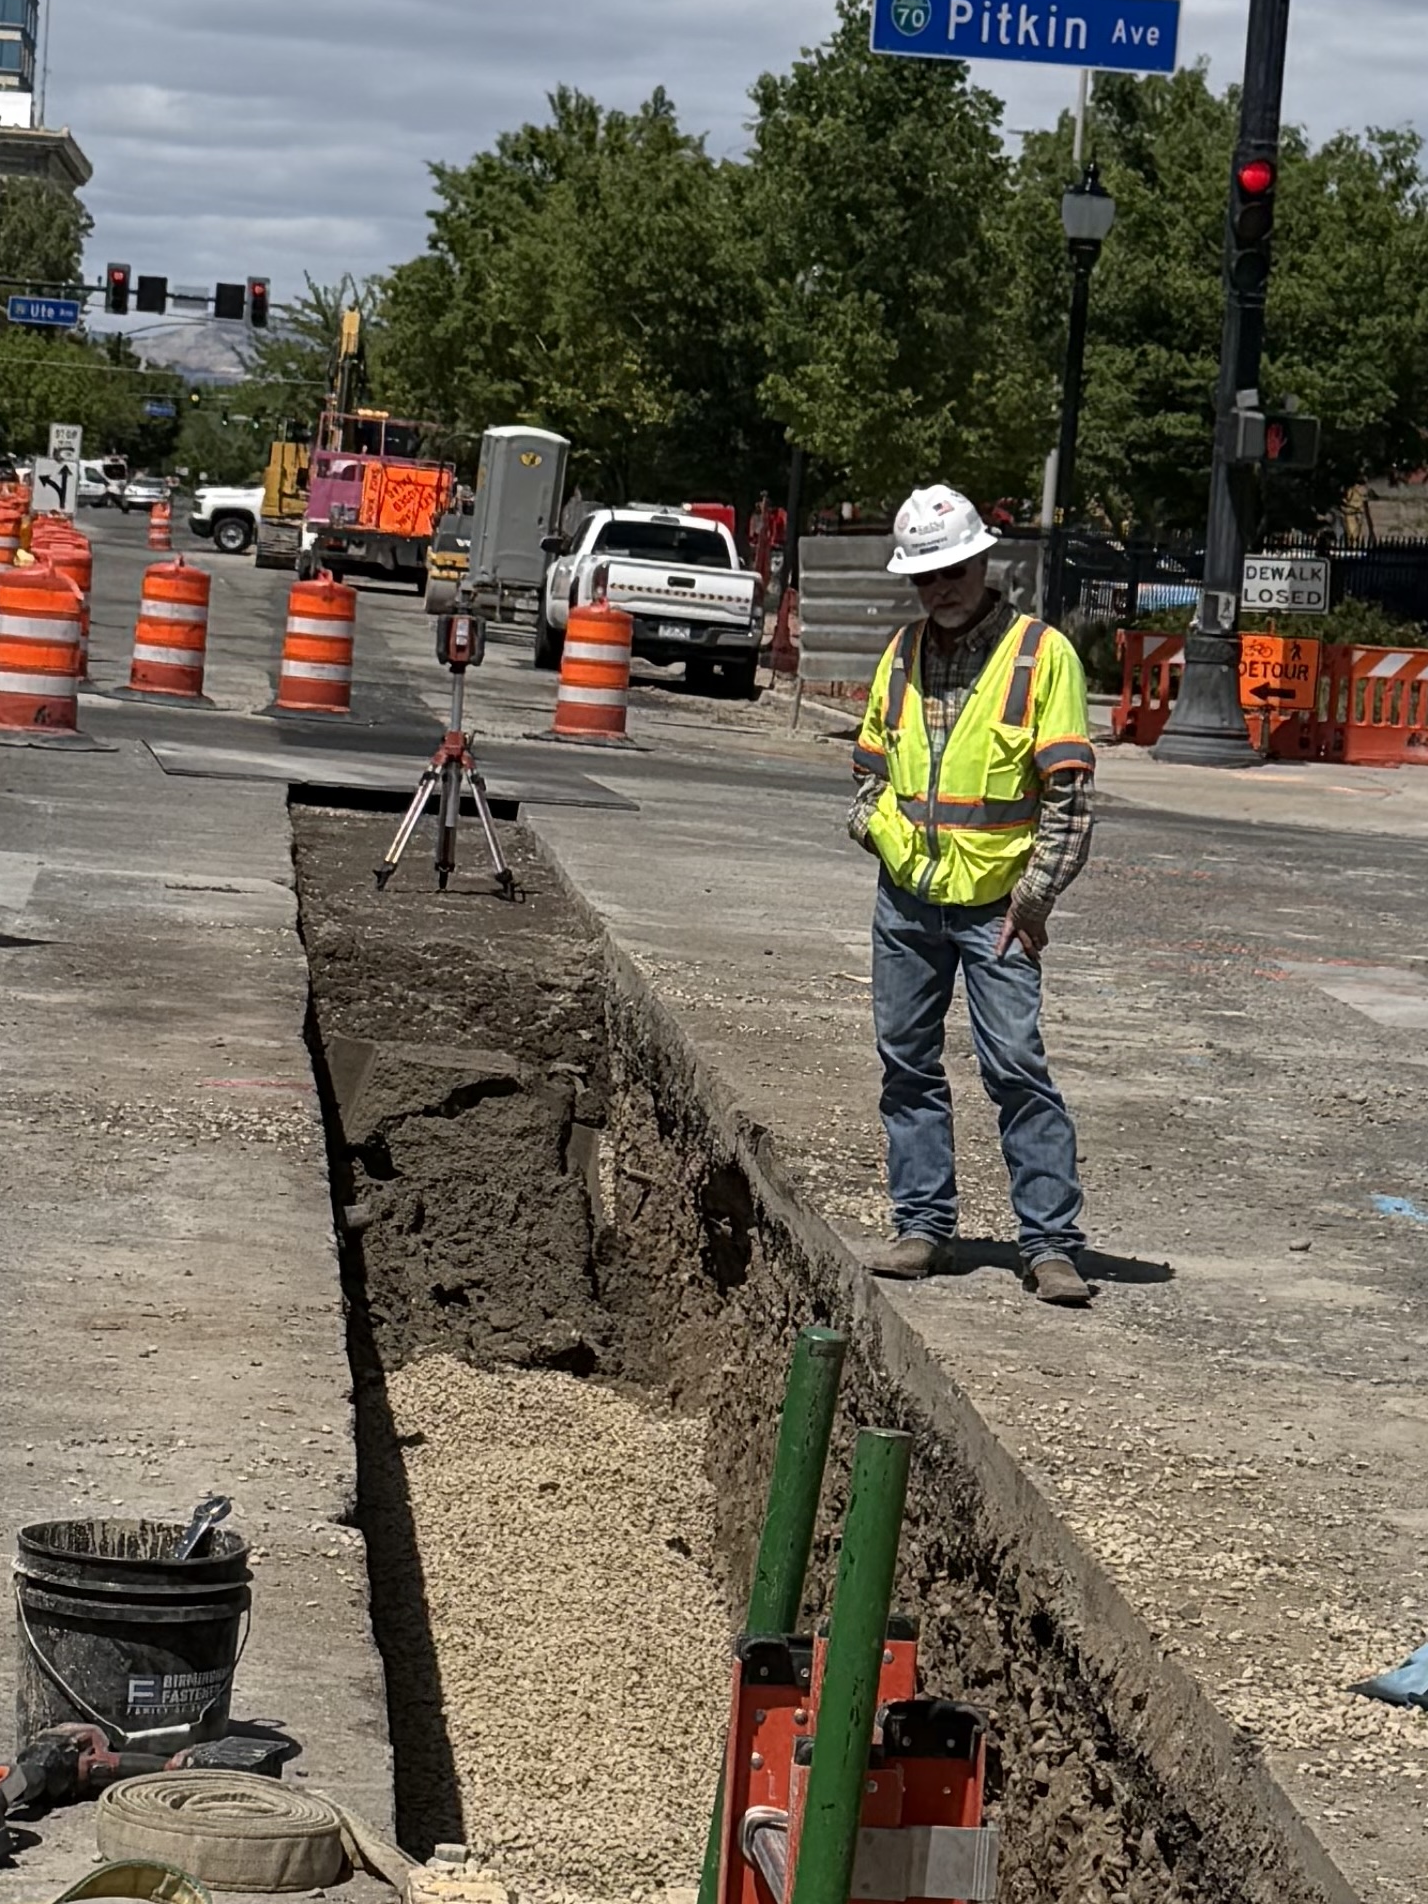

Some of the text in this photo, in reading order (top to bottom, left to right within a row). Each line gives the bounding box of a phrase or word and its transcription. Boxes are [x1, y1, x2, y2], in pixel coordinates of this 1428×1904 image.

[897, 7, 925, 28] 70
[1111, 18, 1161, 46] Ave
[30, 303, 55, 319] Ute
[1245, 565, 1322, 582] DEWALK
[1243, 588, 1322, 605] LOSED
[1239, 661, 1309, 681] DETOUR
